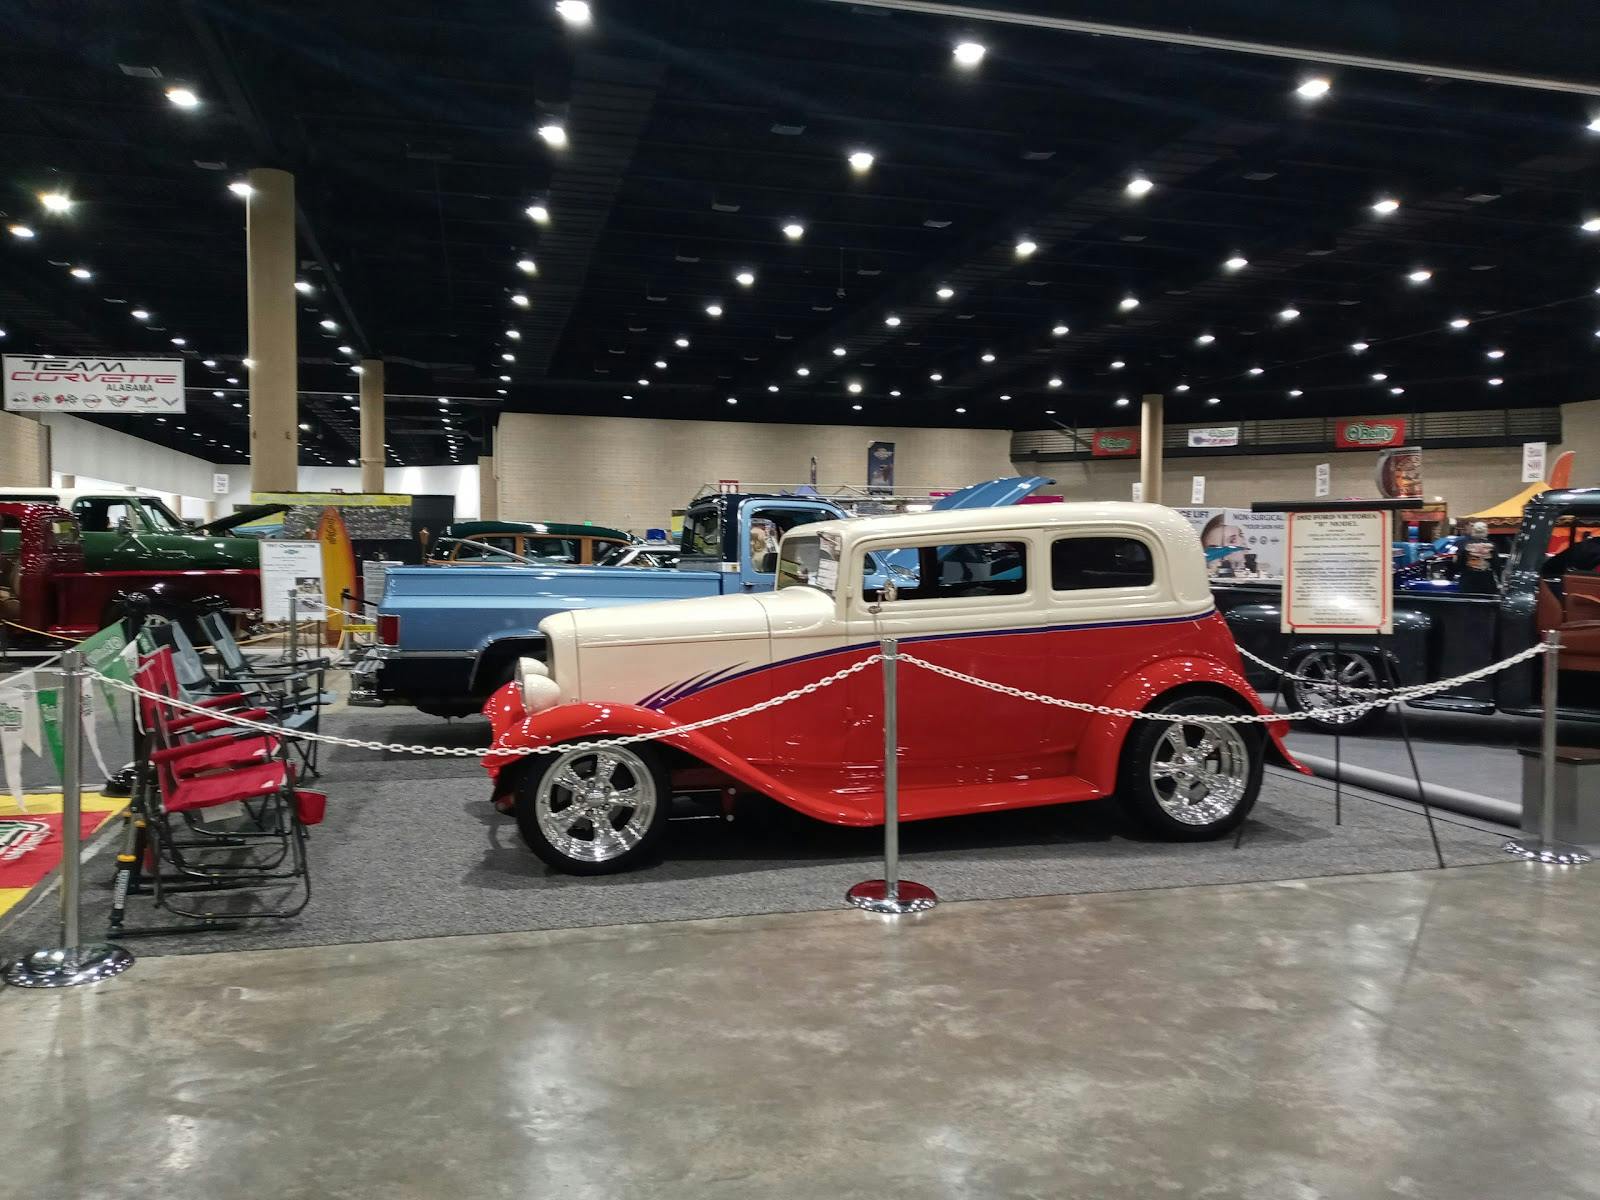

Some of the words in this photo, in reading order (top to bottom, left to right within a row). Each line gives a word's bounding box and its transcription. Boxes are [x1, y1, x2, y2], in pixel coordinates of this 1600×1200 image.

[23, 360, 127, 372] TEAM
[11, 372, 177, 384] CORVETTE
[106, 384, 154, 392] ALABAMA
